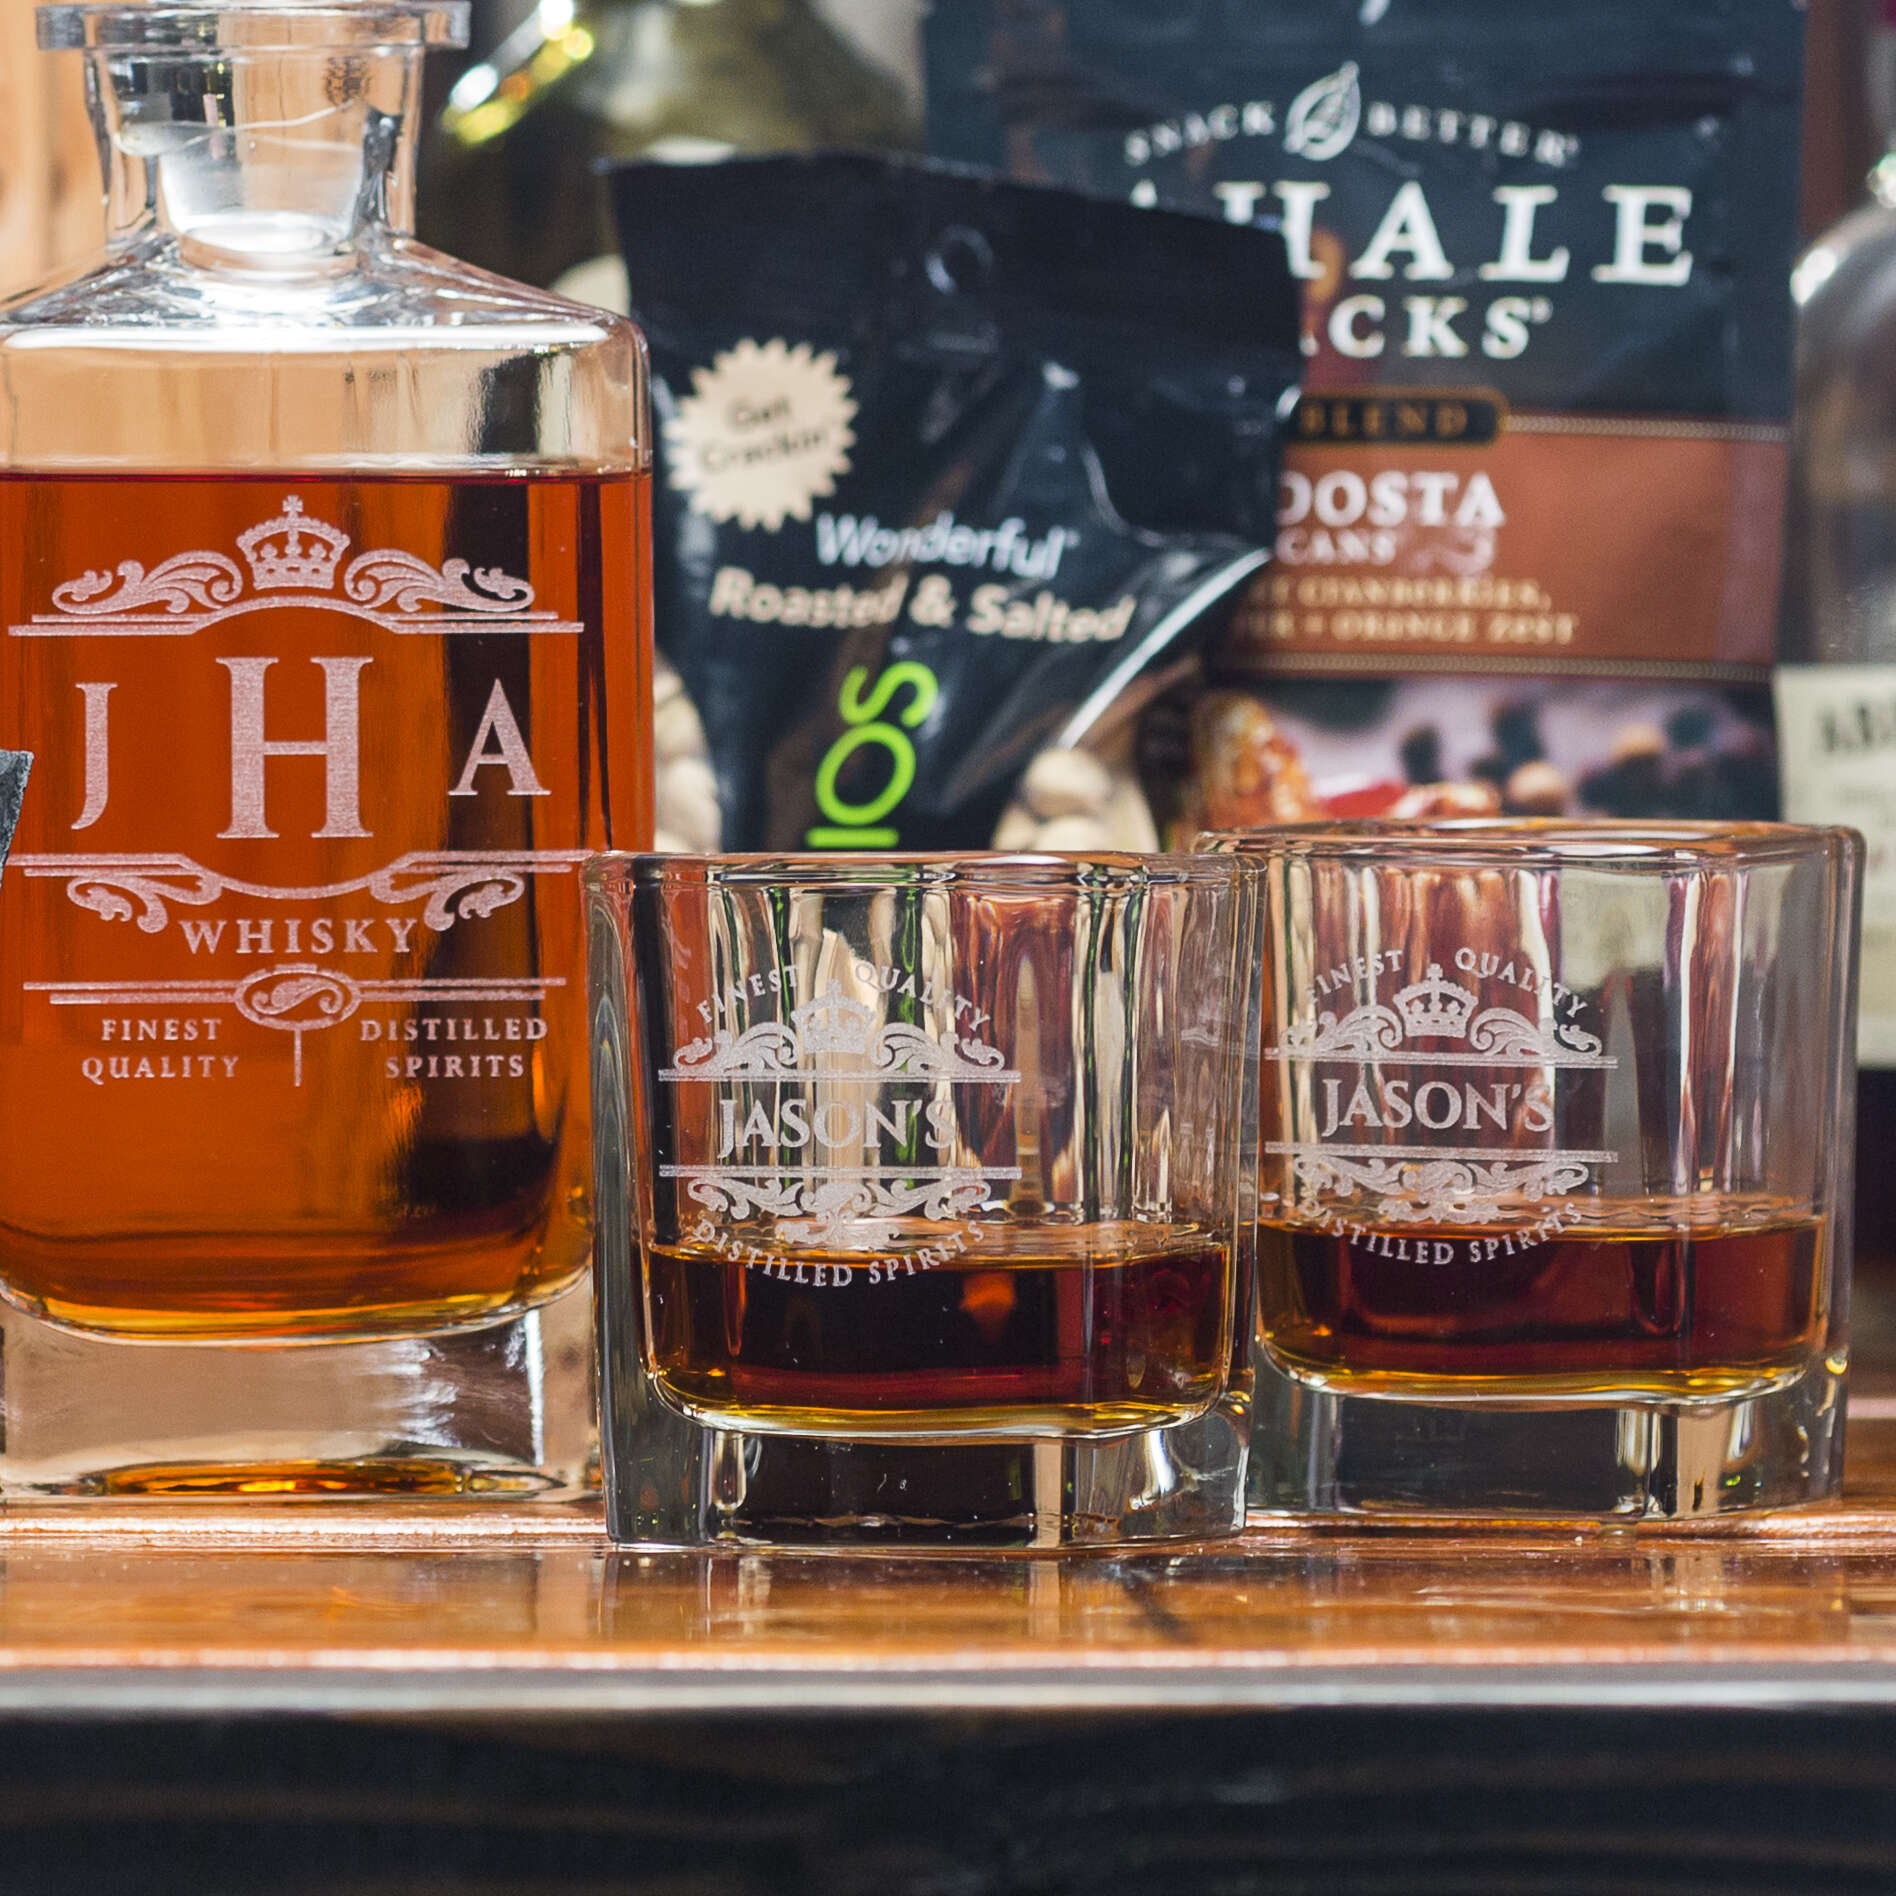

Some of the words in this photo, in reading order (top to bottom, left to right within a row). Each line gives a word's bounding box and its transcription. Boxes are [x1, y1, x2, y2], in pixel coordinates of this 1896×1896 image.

[1124, 101, 1277, 167] SNACK
[1367, 101, 1572, 167] BETTER
[1130, 180, 1694, 286] HALE
[816, 511, 1067, 580] Wonderful
[1275, 528, 1399, 566] CANS
[709, 566, 910, 628] Roasted
[909, 574, 956, 629] &
[966, 583, 1137, 643] Salted
[71, 681, 118, 831] J
[215, 656, 374, 839] H
[447, 677, 551, 797] A
[178, 918, 419, 955] WHISKY
[696, 963, 800, 1024] FINEST
[855, 960, 992, 1032] QUALITY
[1454, 947, 1589, 1019] QUALITY
[101, 1018, 222, 1042] FINEST
[360, 1017, 549, 1042] DISTILLED
[80, 1054, 240, 1086] QUALITY
[385, 1053, 525, 1080] SPIRITS
[717, 1098, 957, 1159] JASON'S
[1321, 1078, 1554, 1138] JASON'S
[693, 1218, 853, 1288] DISTILLED
[868, 1220, 986, 1285] SPIRITS
[1298, 1200, 1455, 1266] DISTILLED
[1469, 1201, 1583, 1264] SPIRITS
